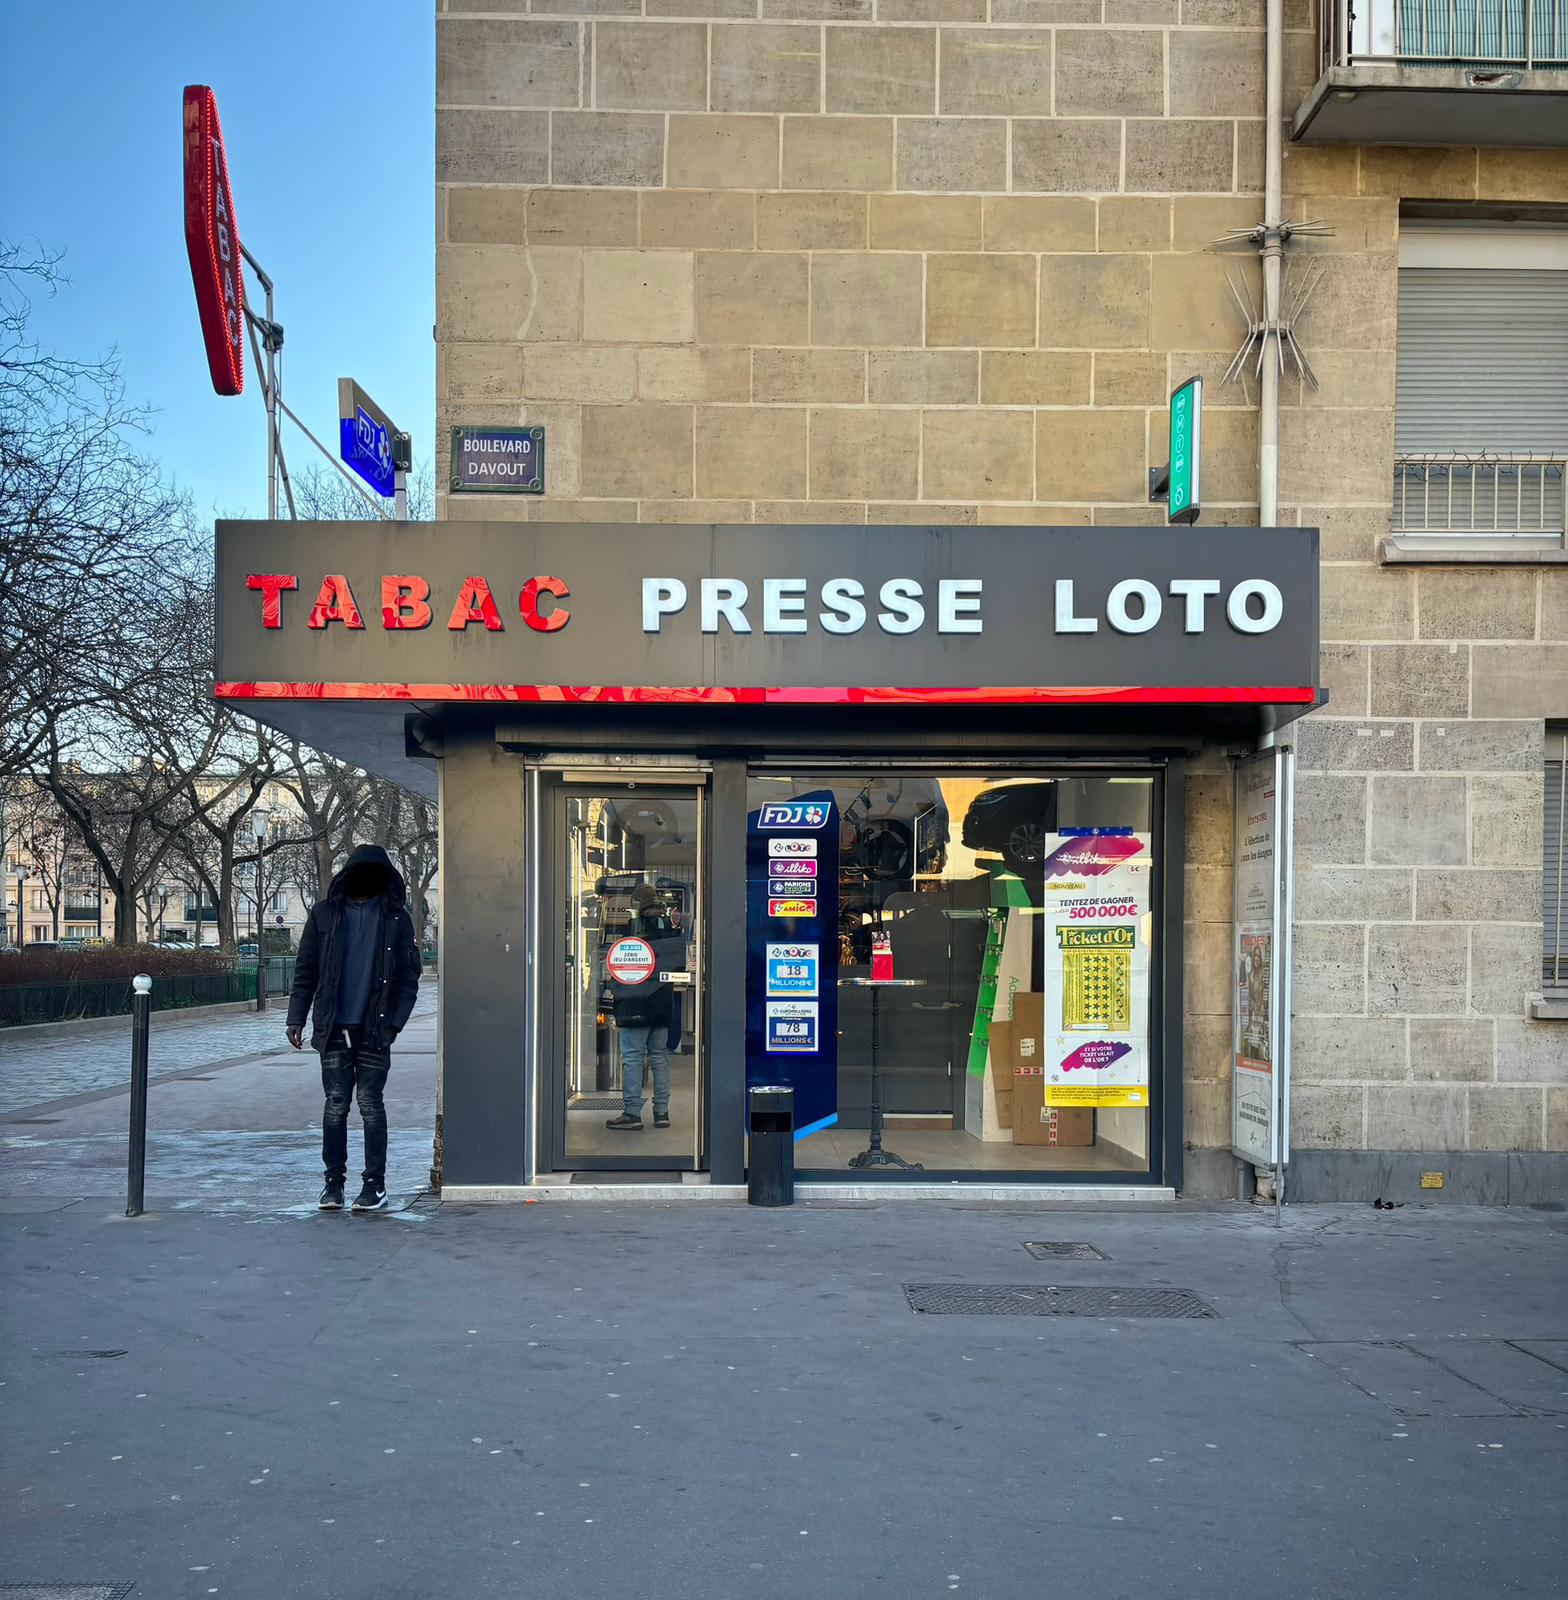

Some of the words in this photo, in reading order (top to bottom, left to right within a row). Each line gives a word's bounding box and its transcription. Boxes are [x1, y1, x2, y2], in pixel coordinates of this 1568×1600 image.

[211, 135, 239, 347] TABAC
[358, 415, 375, 449] FDJ
[464, 439, 531, 454] BOULEVARD
[468, 462, 526, 476] DAVOUT
[245, 574, 571, 633] TABAC
[642, 577, 984, 634] PRESSE
[1055, 578, 1284, 634] LOTO
[764, 807, 803, 823] FDJ
[784, 841, 812, 853] LOTO
[784, 862, 812, 874] illiko
[783, 902, 814, 913] AMIGO
[1060, 898, 1089, 907] TENTEZ
[1089, 898, 1100, 906] DE
[1100, 896, 1134, 905] GAGNER
[1069, 906, 1097, 919] 500
[1098, 904, 1138, 918] 000€
[1057, 927, 1102, 946] Ticket
[1103, 927, 1134, 943] d'Or
[783, 947, 813, 958] LOTO
[787, 966, 801, 976] 18
[786, 1023, 801, 1033] 78
